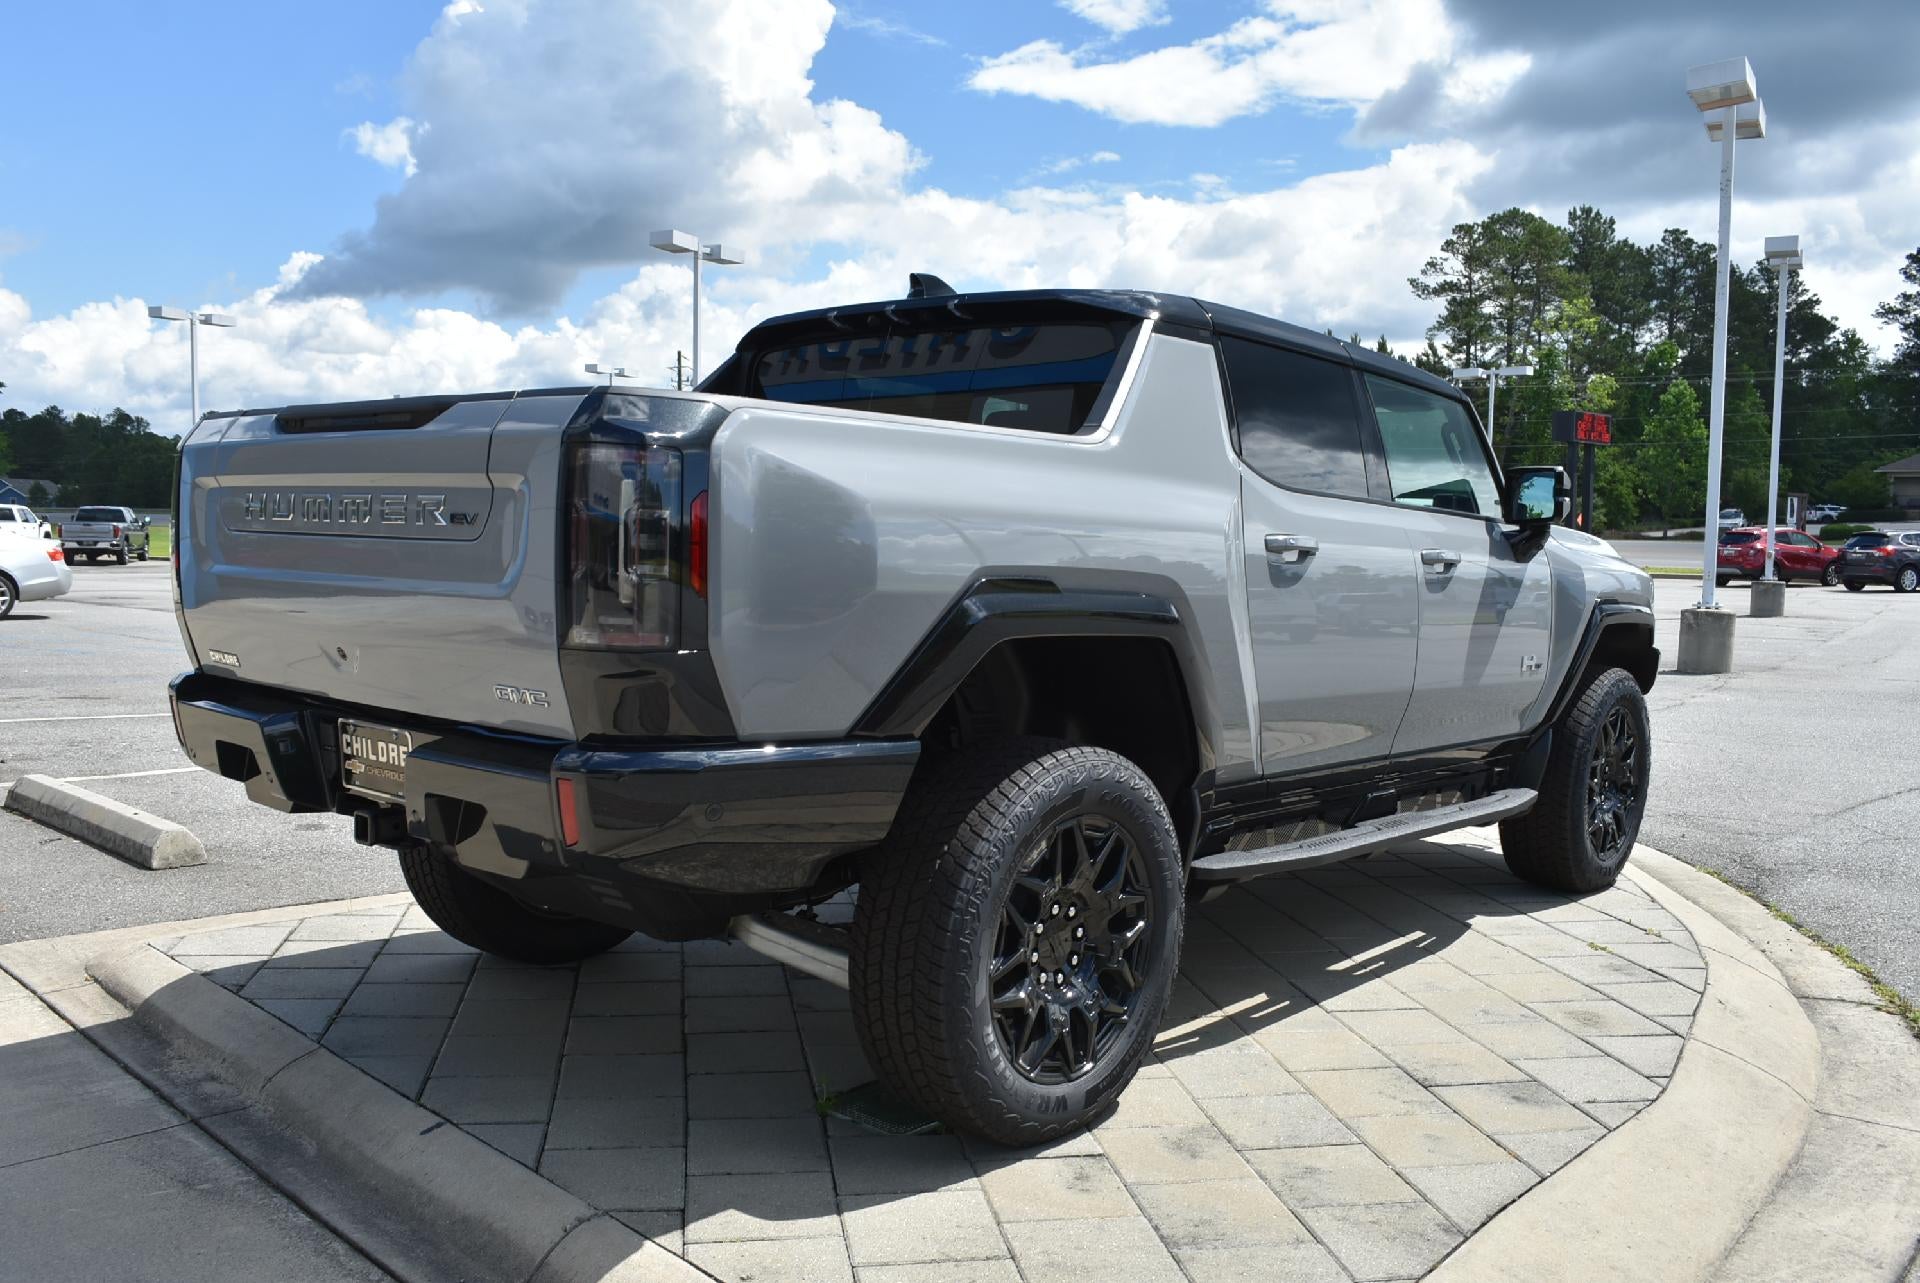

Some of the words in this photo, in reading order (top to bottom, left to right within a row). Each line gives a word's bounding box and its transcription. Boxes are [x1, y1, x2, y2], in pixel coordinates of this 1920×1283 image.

[245, 493, 448, 526] HUMMER
[450, 513, 479, 526] EV
[494, 684, 549, 708] GMC
[342, 733, 408, 767] CHILDRE
[366, 766, 406, 781] CHEVROLE
